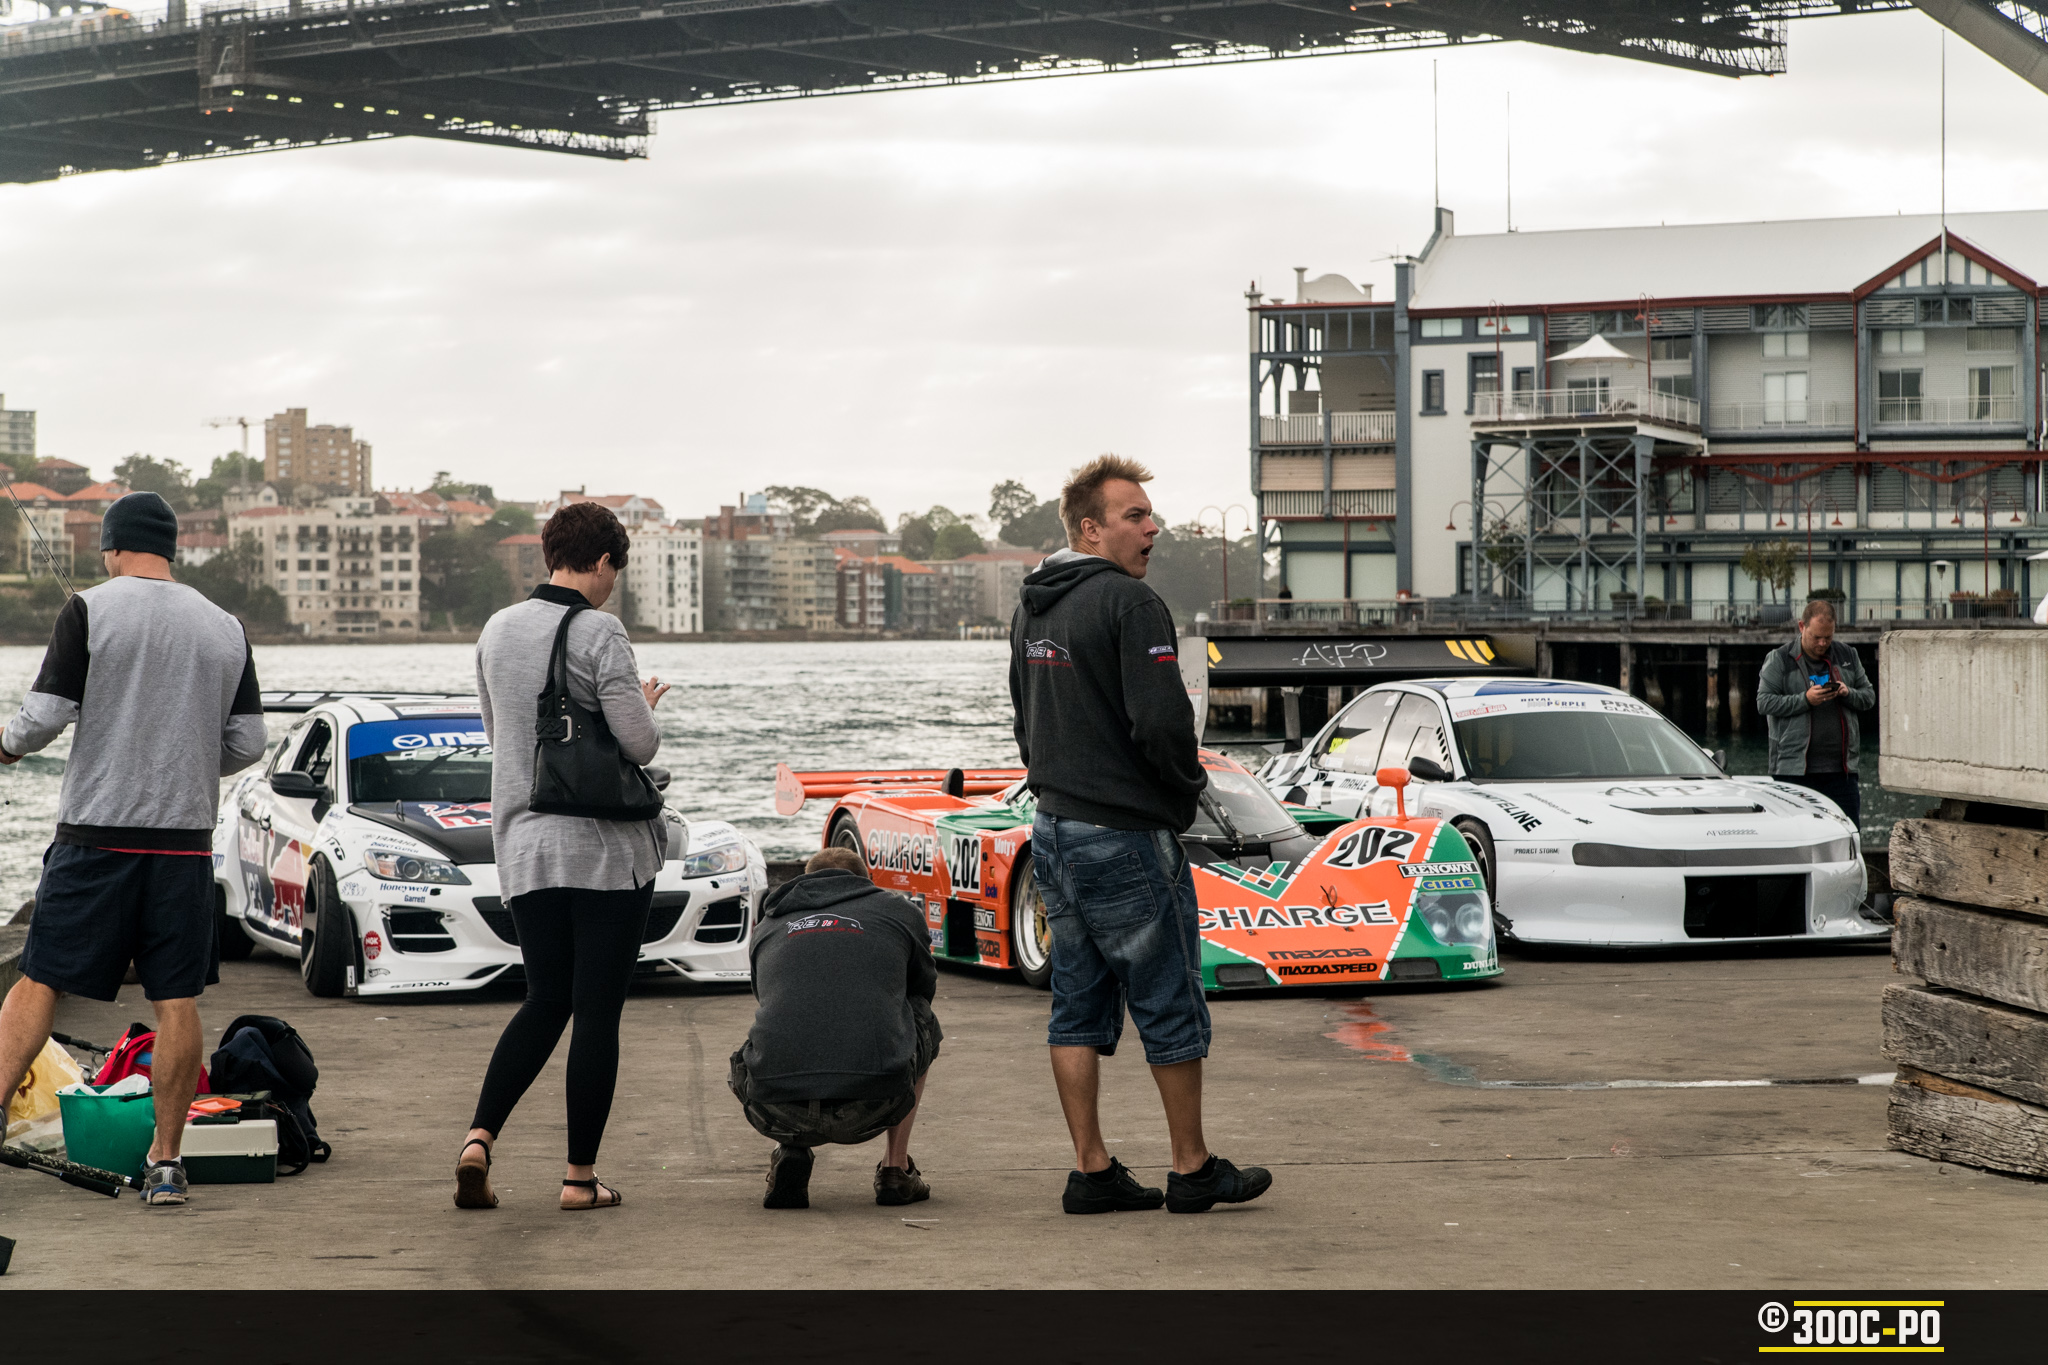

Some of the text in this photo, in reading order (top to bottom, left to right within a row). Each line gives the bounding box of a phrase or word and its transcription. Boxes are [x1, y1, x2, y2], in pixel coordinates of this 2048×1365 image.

[1292, 643, 1387, 668] AFP
[1600, 699, 1645, 711] PRO
[1339, 778, 1369, 791] MAHLE
[867, 828, 934, 876] CHARGE
[1327, 827, 1415, 867] 202
[951, 837, 980, 890] 202
[1407, 863, 1474, 876] RENOWN
[380, 882, 429, 893] Honeywell
[404, 894, 426, 903] Garrett
[929, 902, 941, 917] NGK
[366, 937, 379, 945] NGK
[1278, 962, 1378, 976] MAZDASPEED
